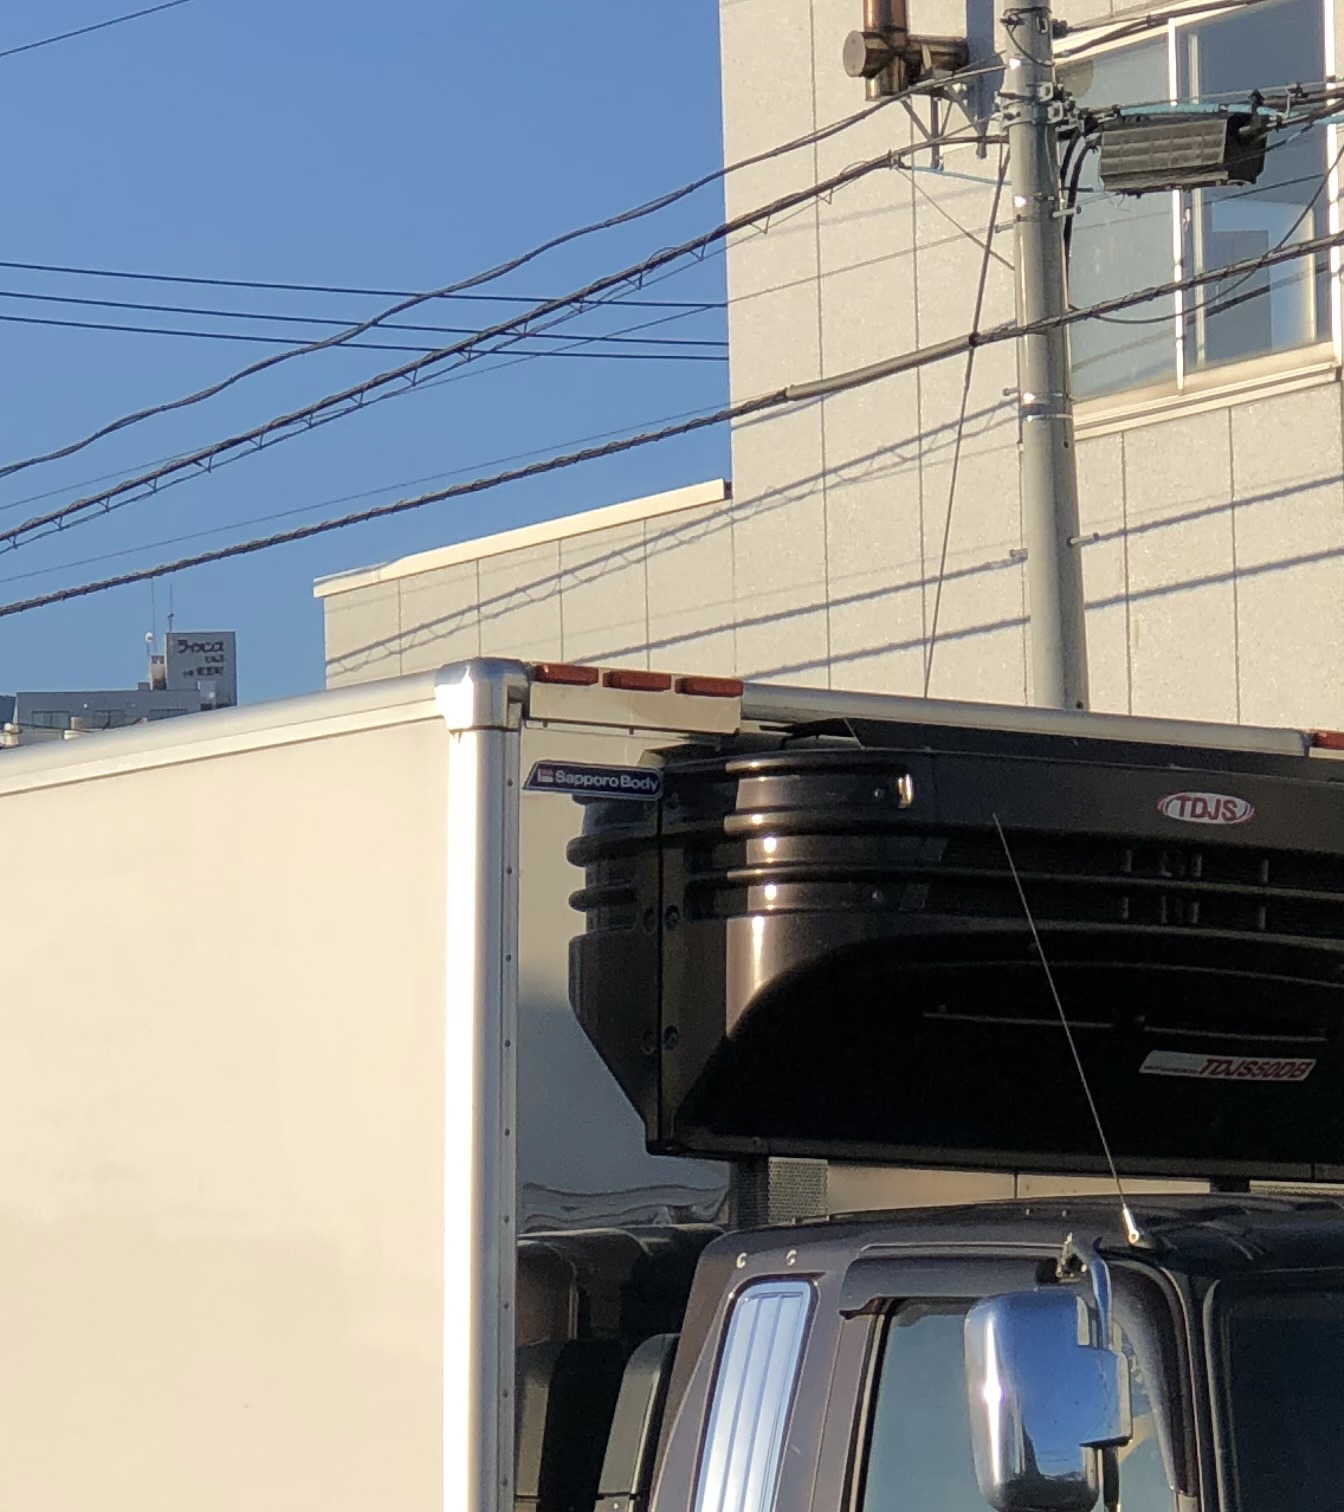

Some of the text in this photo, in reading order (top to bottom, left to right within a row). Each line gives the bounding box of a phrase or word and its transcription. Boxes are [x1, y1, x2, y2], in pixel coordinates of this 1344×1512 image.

[555, 769, 658, 792] Sapporo Body
[1175, 795, 1238, 822] TDJS
